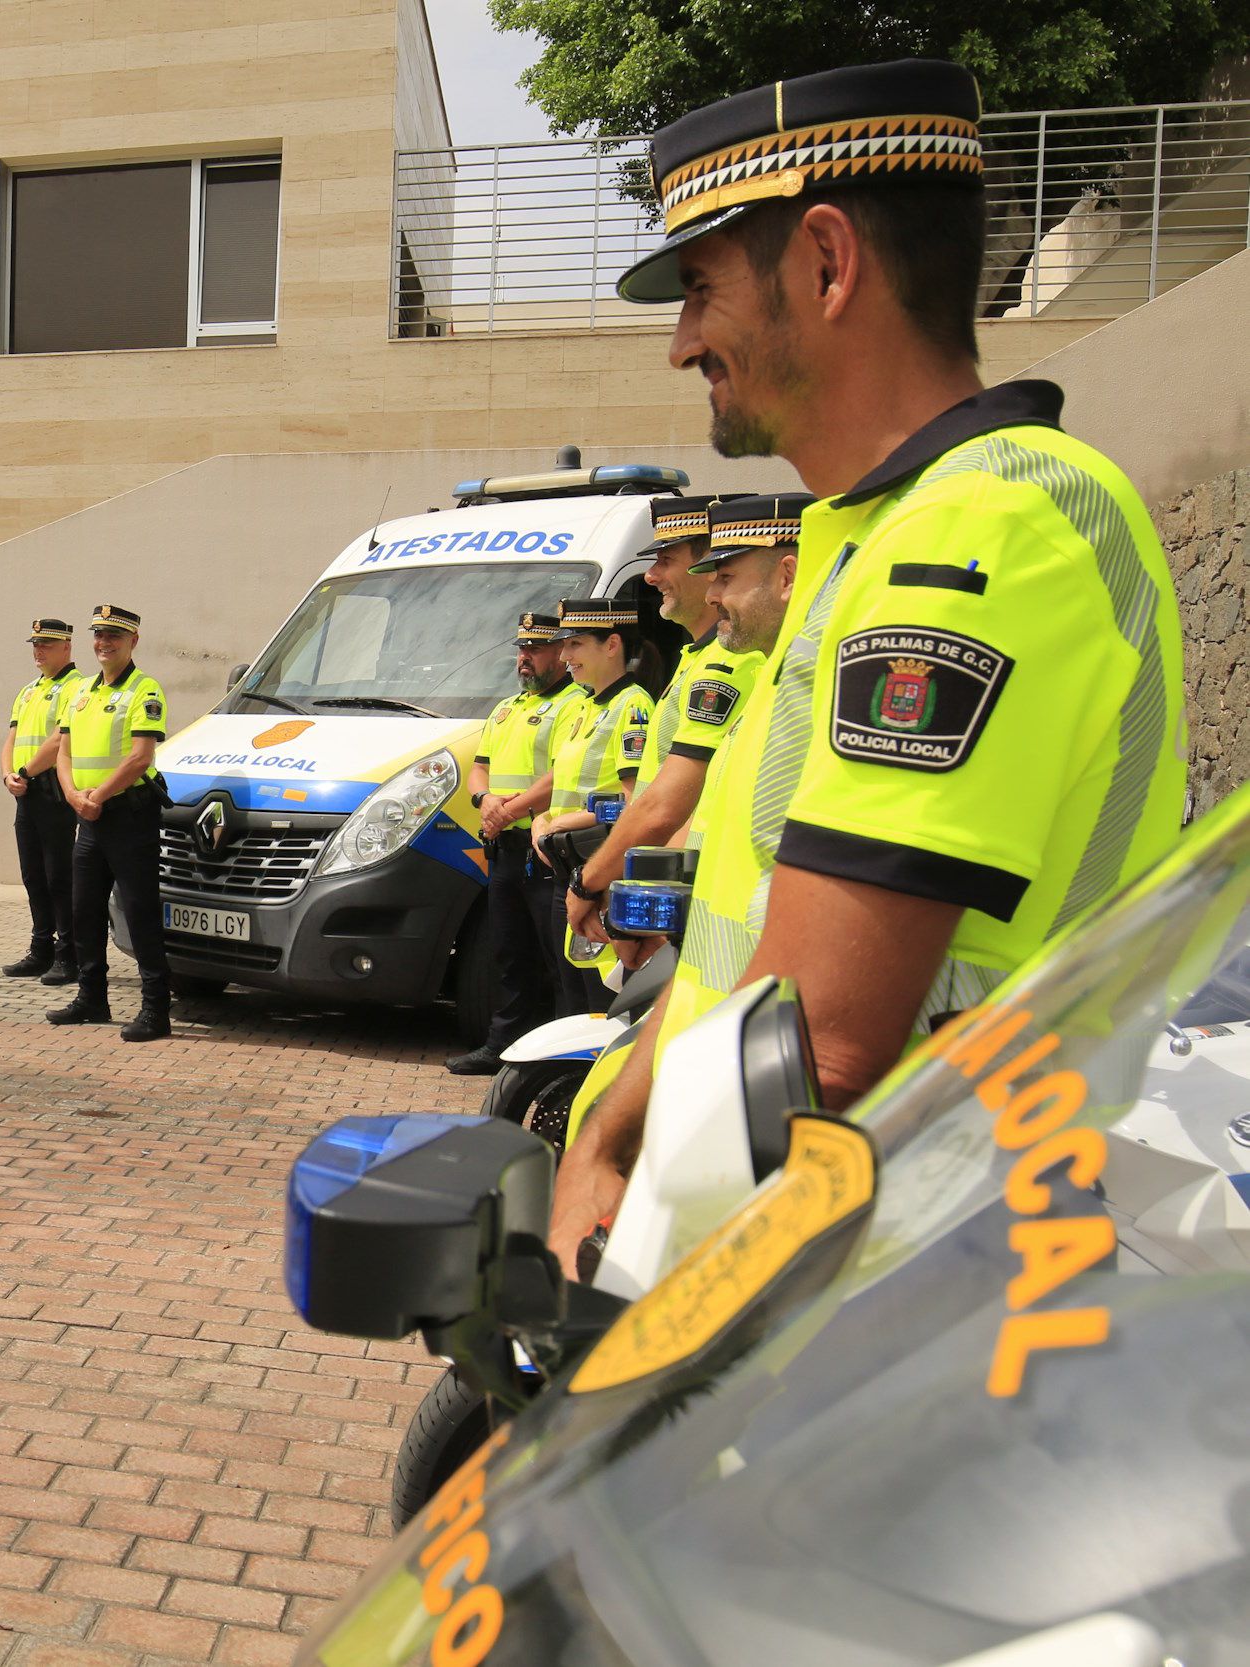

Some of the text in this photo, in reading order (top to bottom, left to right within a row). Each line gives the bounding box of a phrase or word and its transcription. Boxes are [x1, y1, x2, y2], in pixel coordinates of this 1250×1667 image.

[358, 531, 574, 566] ATESTADOS
[842, 636, 992, 674] LAS PALMAS DE G.C.
[700, 682, 720, 690] PALMAS
[838, 732, 953, 760] POLICIA LOCAL
[176, 754, 317, 772] POLICIA LOCAL
[173, 908, 246, 937] 0976 LGY
[975, 1032, 1117, 1398] LOCAL
